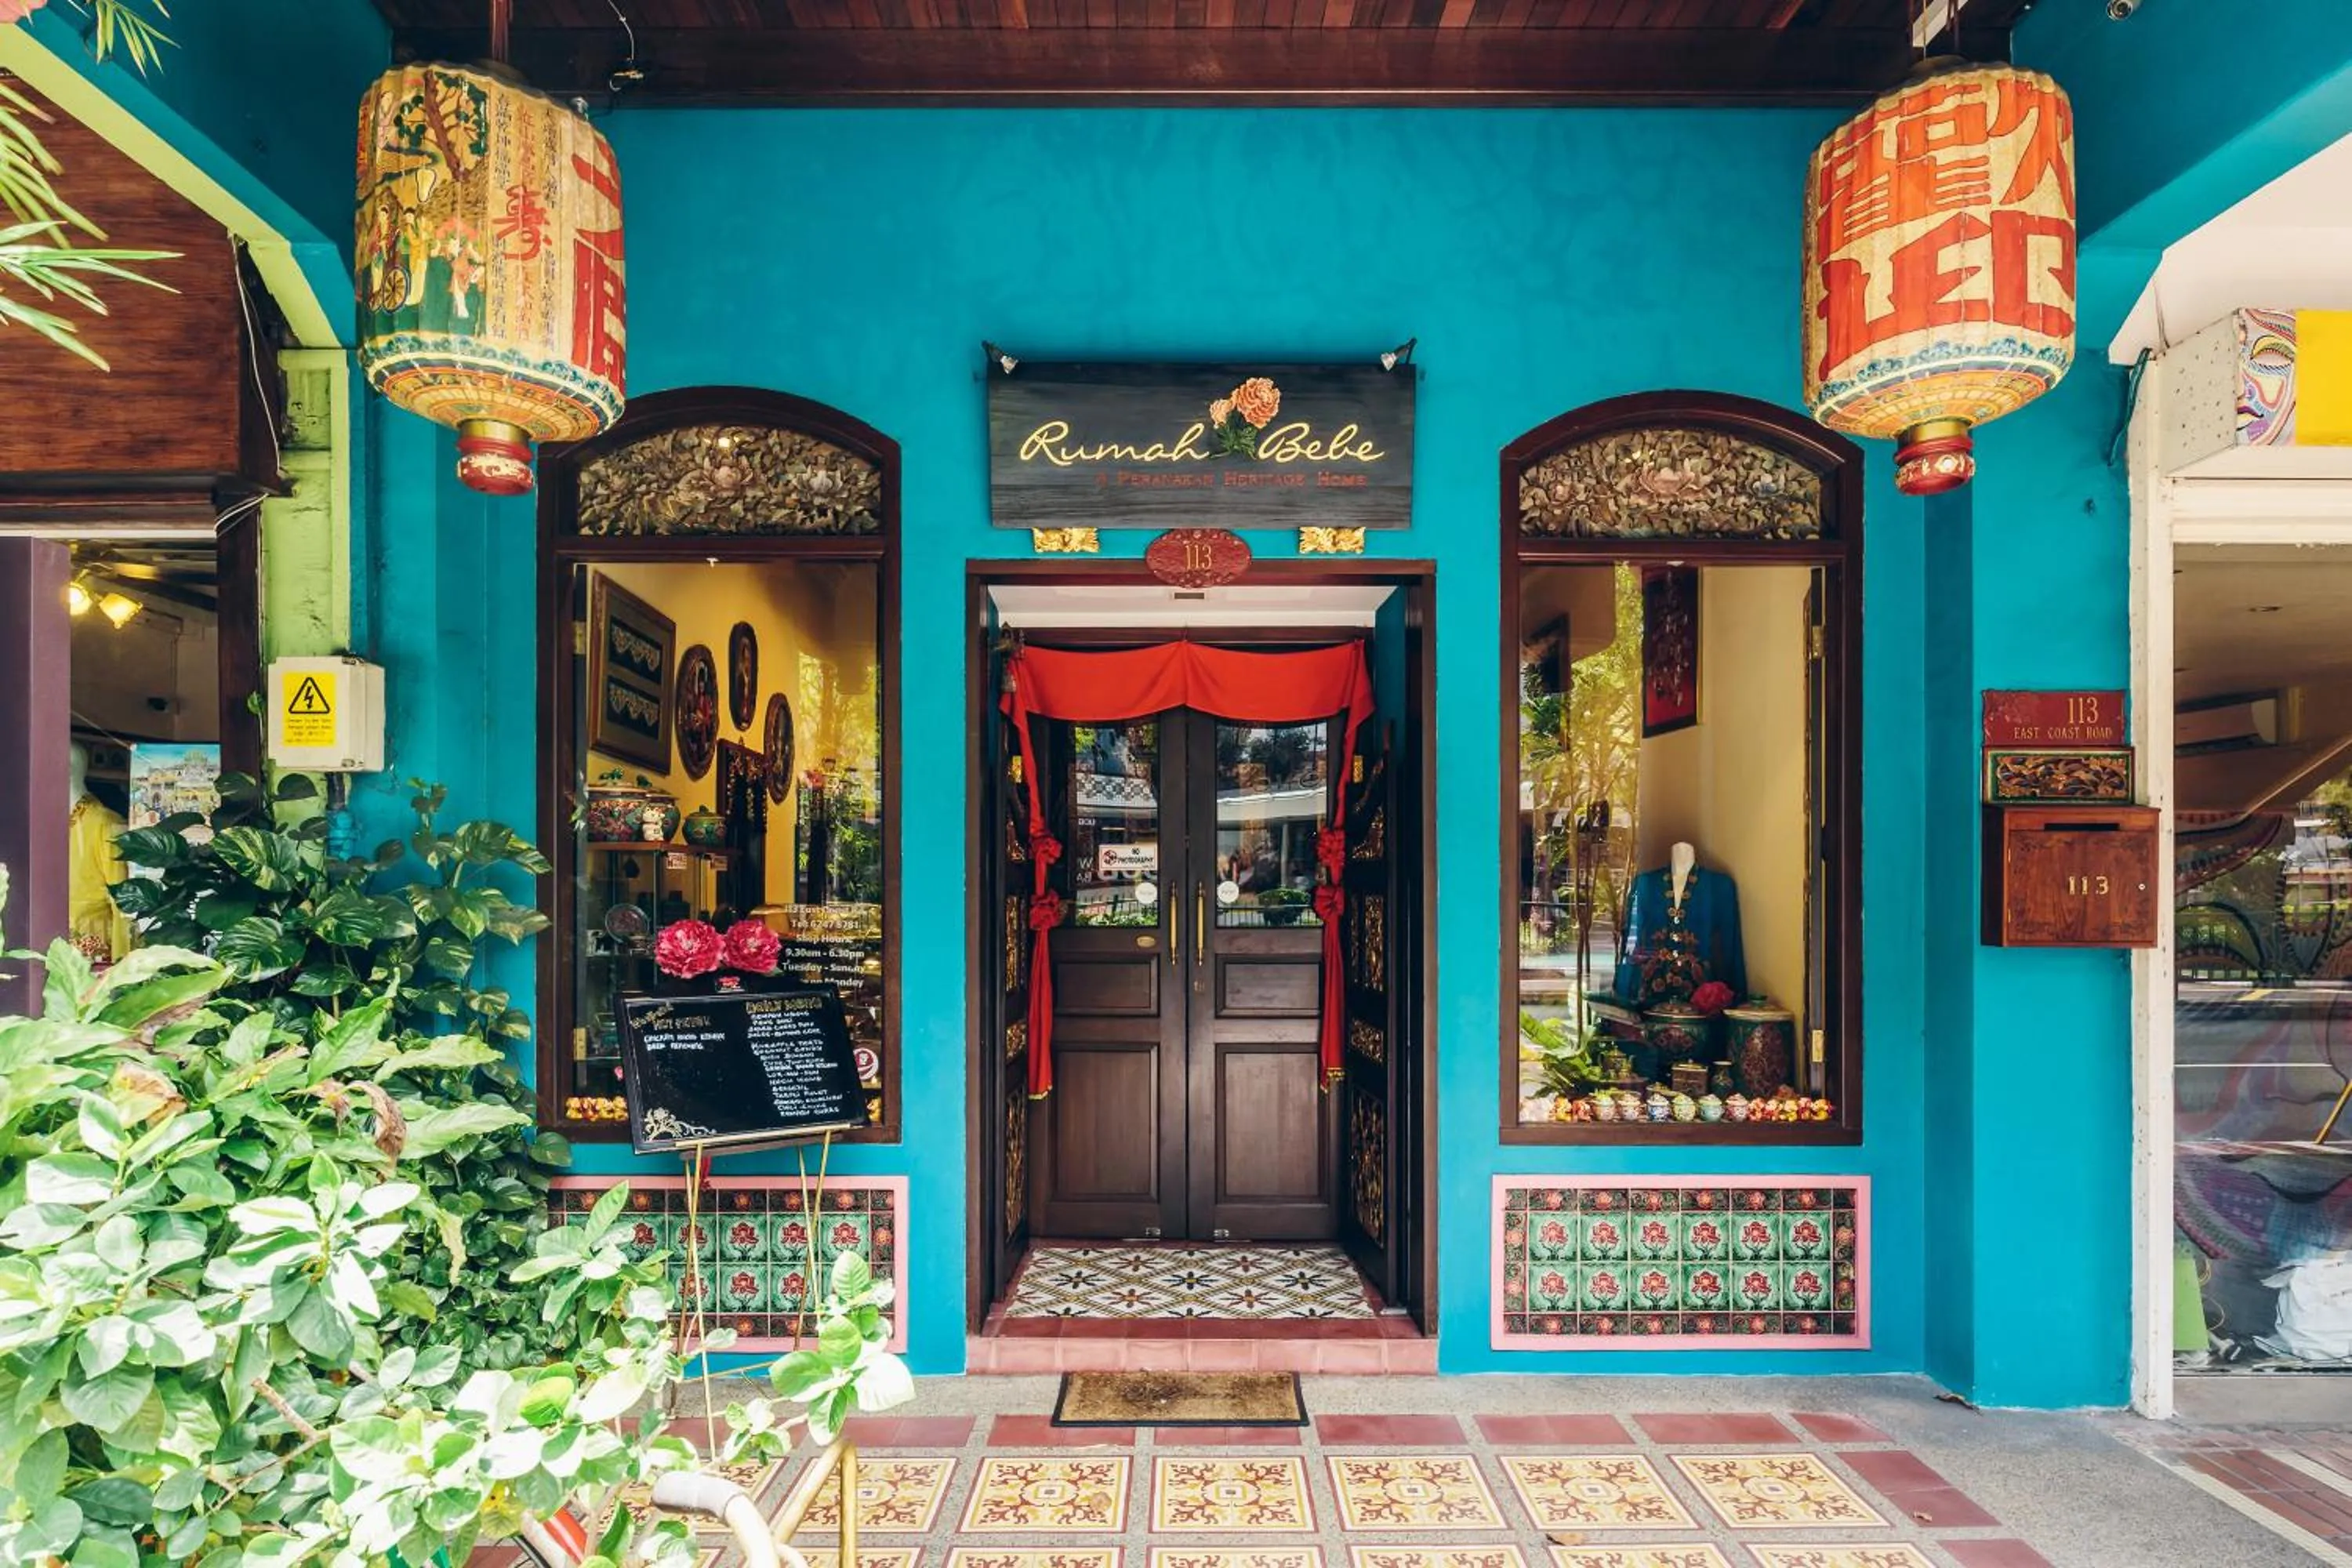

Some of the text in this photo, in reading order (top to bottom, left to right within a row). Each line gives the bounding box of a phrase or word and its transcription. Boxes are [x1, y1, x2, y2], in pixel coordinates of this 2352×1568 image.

[1020, 421, 1385, 466] Rumah Bebe
[1185, 544, 1212, 570] 113
[2067, 696, 2100, 724] 113
[2013, 726, 2113, 739] EAST COAST ROAD
[2067, 875, 2109, 895] 113
[785, 948, 821, 957] 9.30am
[829, 948, 865, 960] 6.30pm
[782, 962, 822, 972] Tuesday
